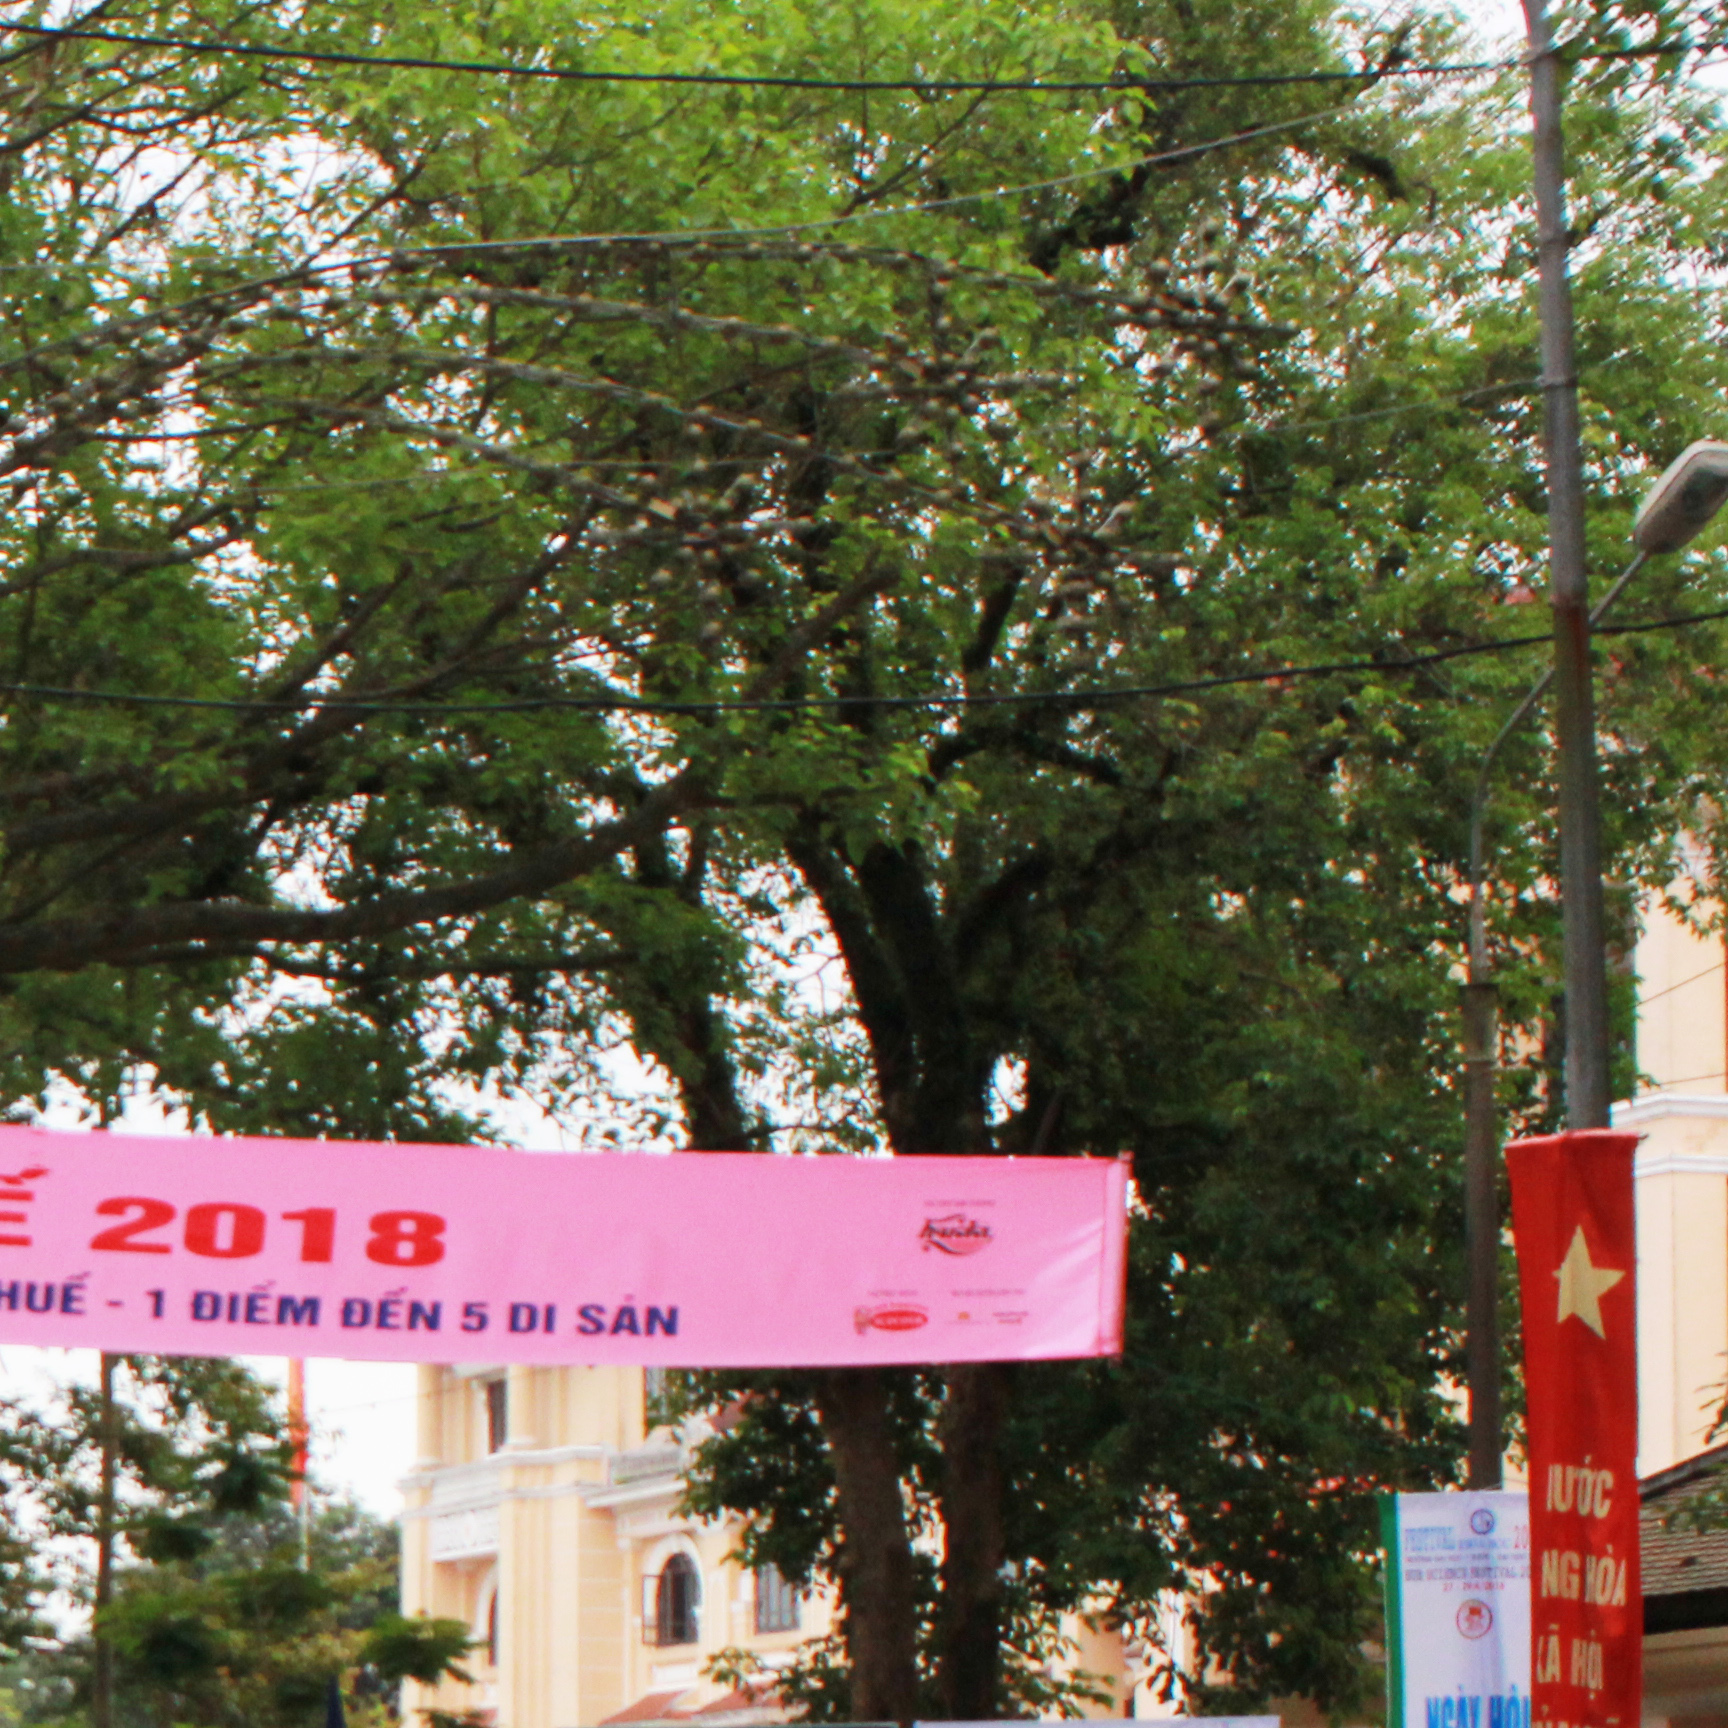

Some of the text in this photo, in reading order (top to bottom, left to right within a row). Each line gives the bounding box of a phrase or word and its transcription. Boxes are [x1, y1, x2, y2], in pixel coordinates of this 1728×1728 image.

[89, 1195, 446, 1267] 2018
[146, 1288, 165, 1318] 1
[340, 1286, 442, 1331] ĐẾN
[461, 1303, 488, 1333] 5
[509, 1302, 556, 1335] DI
